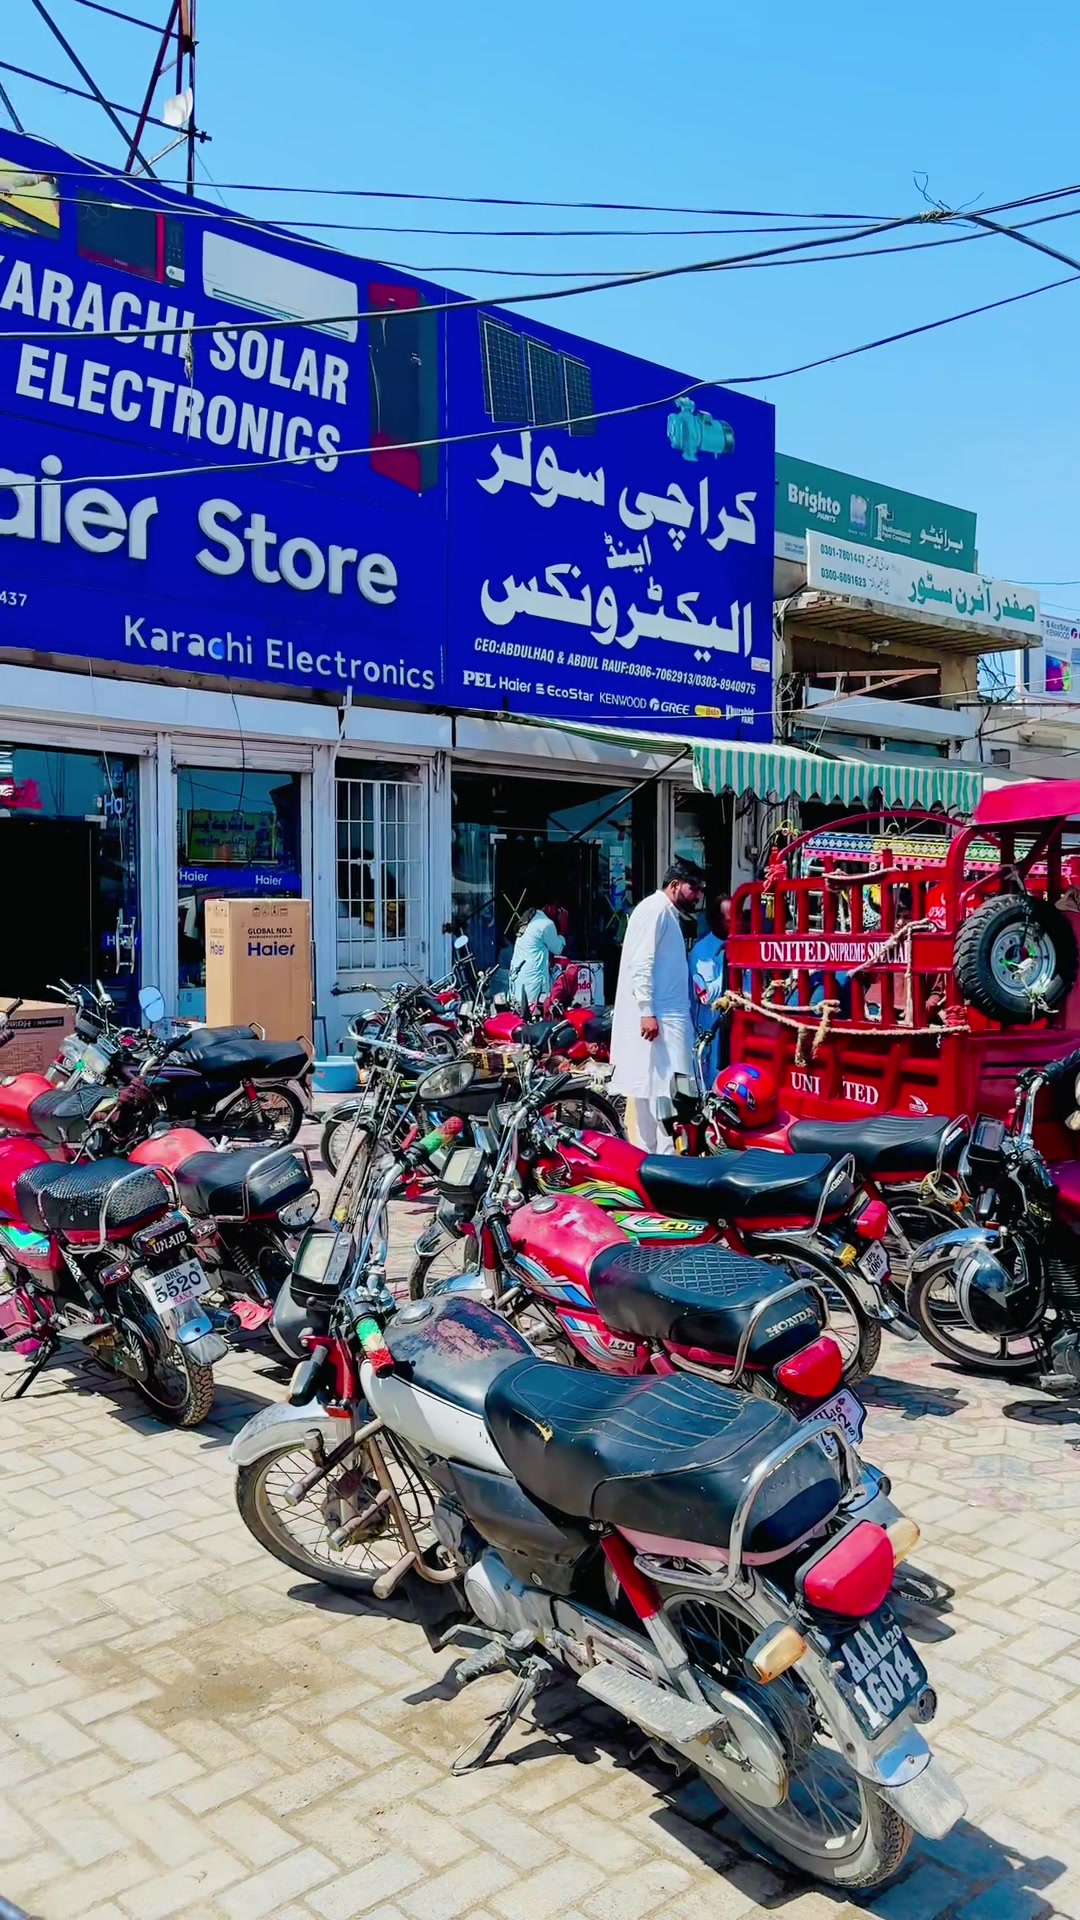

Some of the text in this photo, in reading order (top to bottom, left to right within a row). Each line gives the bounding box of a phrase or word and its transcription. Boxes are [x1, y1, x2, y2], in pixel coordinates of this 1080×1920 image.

[0, 256, 349, 405] ARACHI SOLAR
[16, 343, 341, 473] ELECTRONICS
[476, 428, 758, 552] کراچی سولر
[787, 483, 842, 514] Brighto
[816, 511, 837, 524] PAINTS
[195, 498, 398, 605] Store
[604, 532, 652, 574] اینڈ
[820, 543, 866, 565] 0301-7801447
[908, 570, 952, 605] سٹور
[481, 564, 752, 661] الیکٹرونکس
[993, 592, 1035, 622] صفدر
[125, 615, 436, 691] Karachi Electronics
[474, 637, 554, 664] CEO:ABDULHAQ
[556, 651, 565, 664] &
[567, 653, 599, 670] ABDUL
[463, 670, 497, 688] PEL
[499, 676, 532, 693] Haier
[547, 685, 594, 702] EcoStar
[599, 692, 647, 709] KENWOOD
[661, 702, 690, 715] GREE
[179, 872, 282, 886] Haier Haier
[247, 927, 293, 935] GLOBAL NO.1
[247, 941, 295, 957] Haier
[760, 941, 830, 963] UNITED
[830, 942, 866, 962] SUPREME
[790, 1071, 879, 1106] UNI TED
[269, 1168, 302, 1190] HONDA
[154, 1270, 202, 1304] 5520
[765, 1307, 816, 1338] HONDA
[840, 1620, 903, 1685] AAL 20
[853, 1644, 921, 1730] 1604
